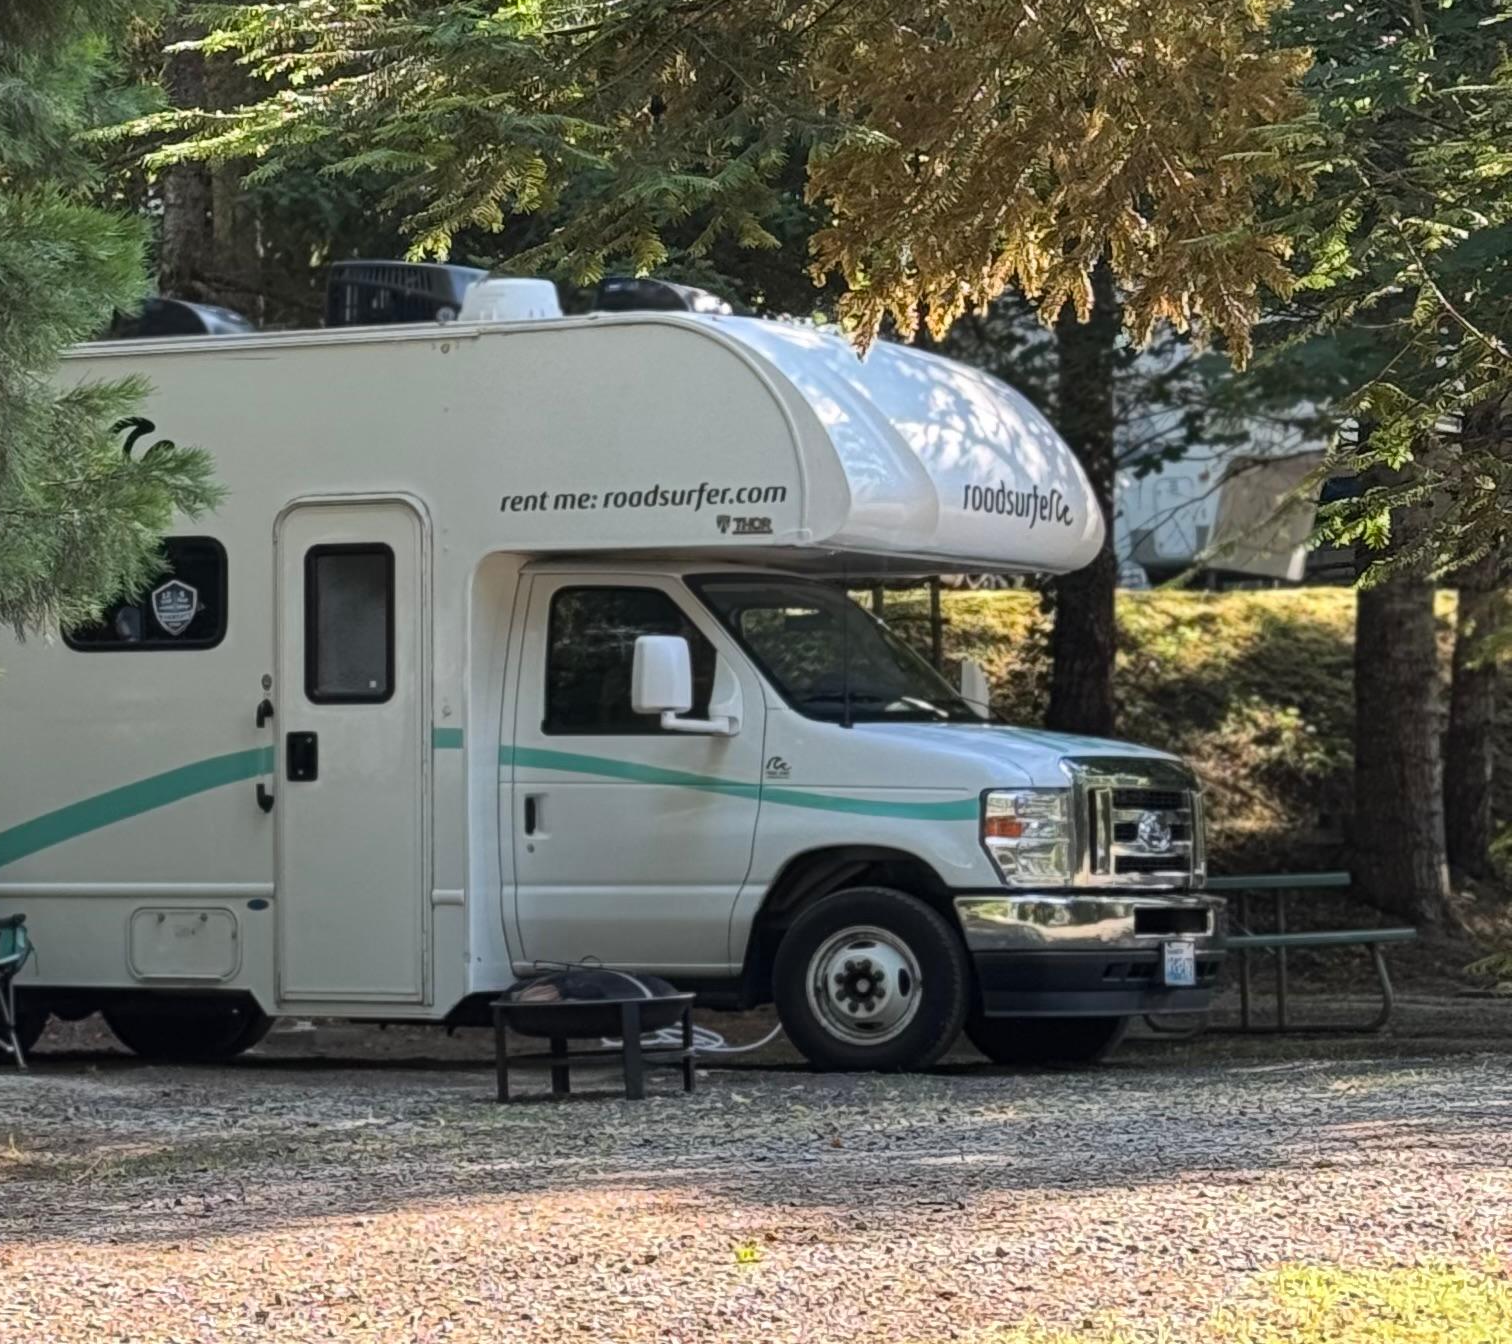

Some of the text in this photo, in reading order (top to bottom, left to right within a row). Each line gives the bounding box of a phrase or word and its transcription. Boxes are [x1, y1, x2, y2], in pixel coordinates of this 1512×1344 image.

[500, 482, 787, 512] rent me: roadsurfer.com
[732, 516, 773, 535] THOR
